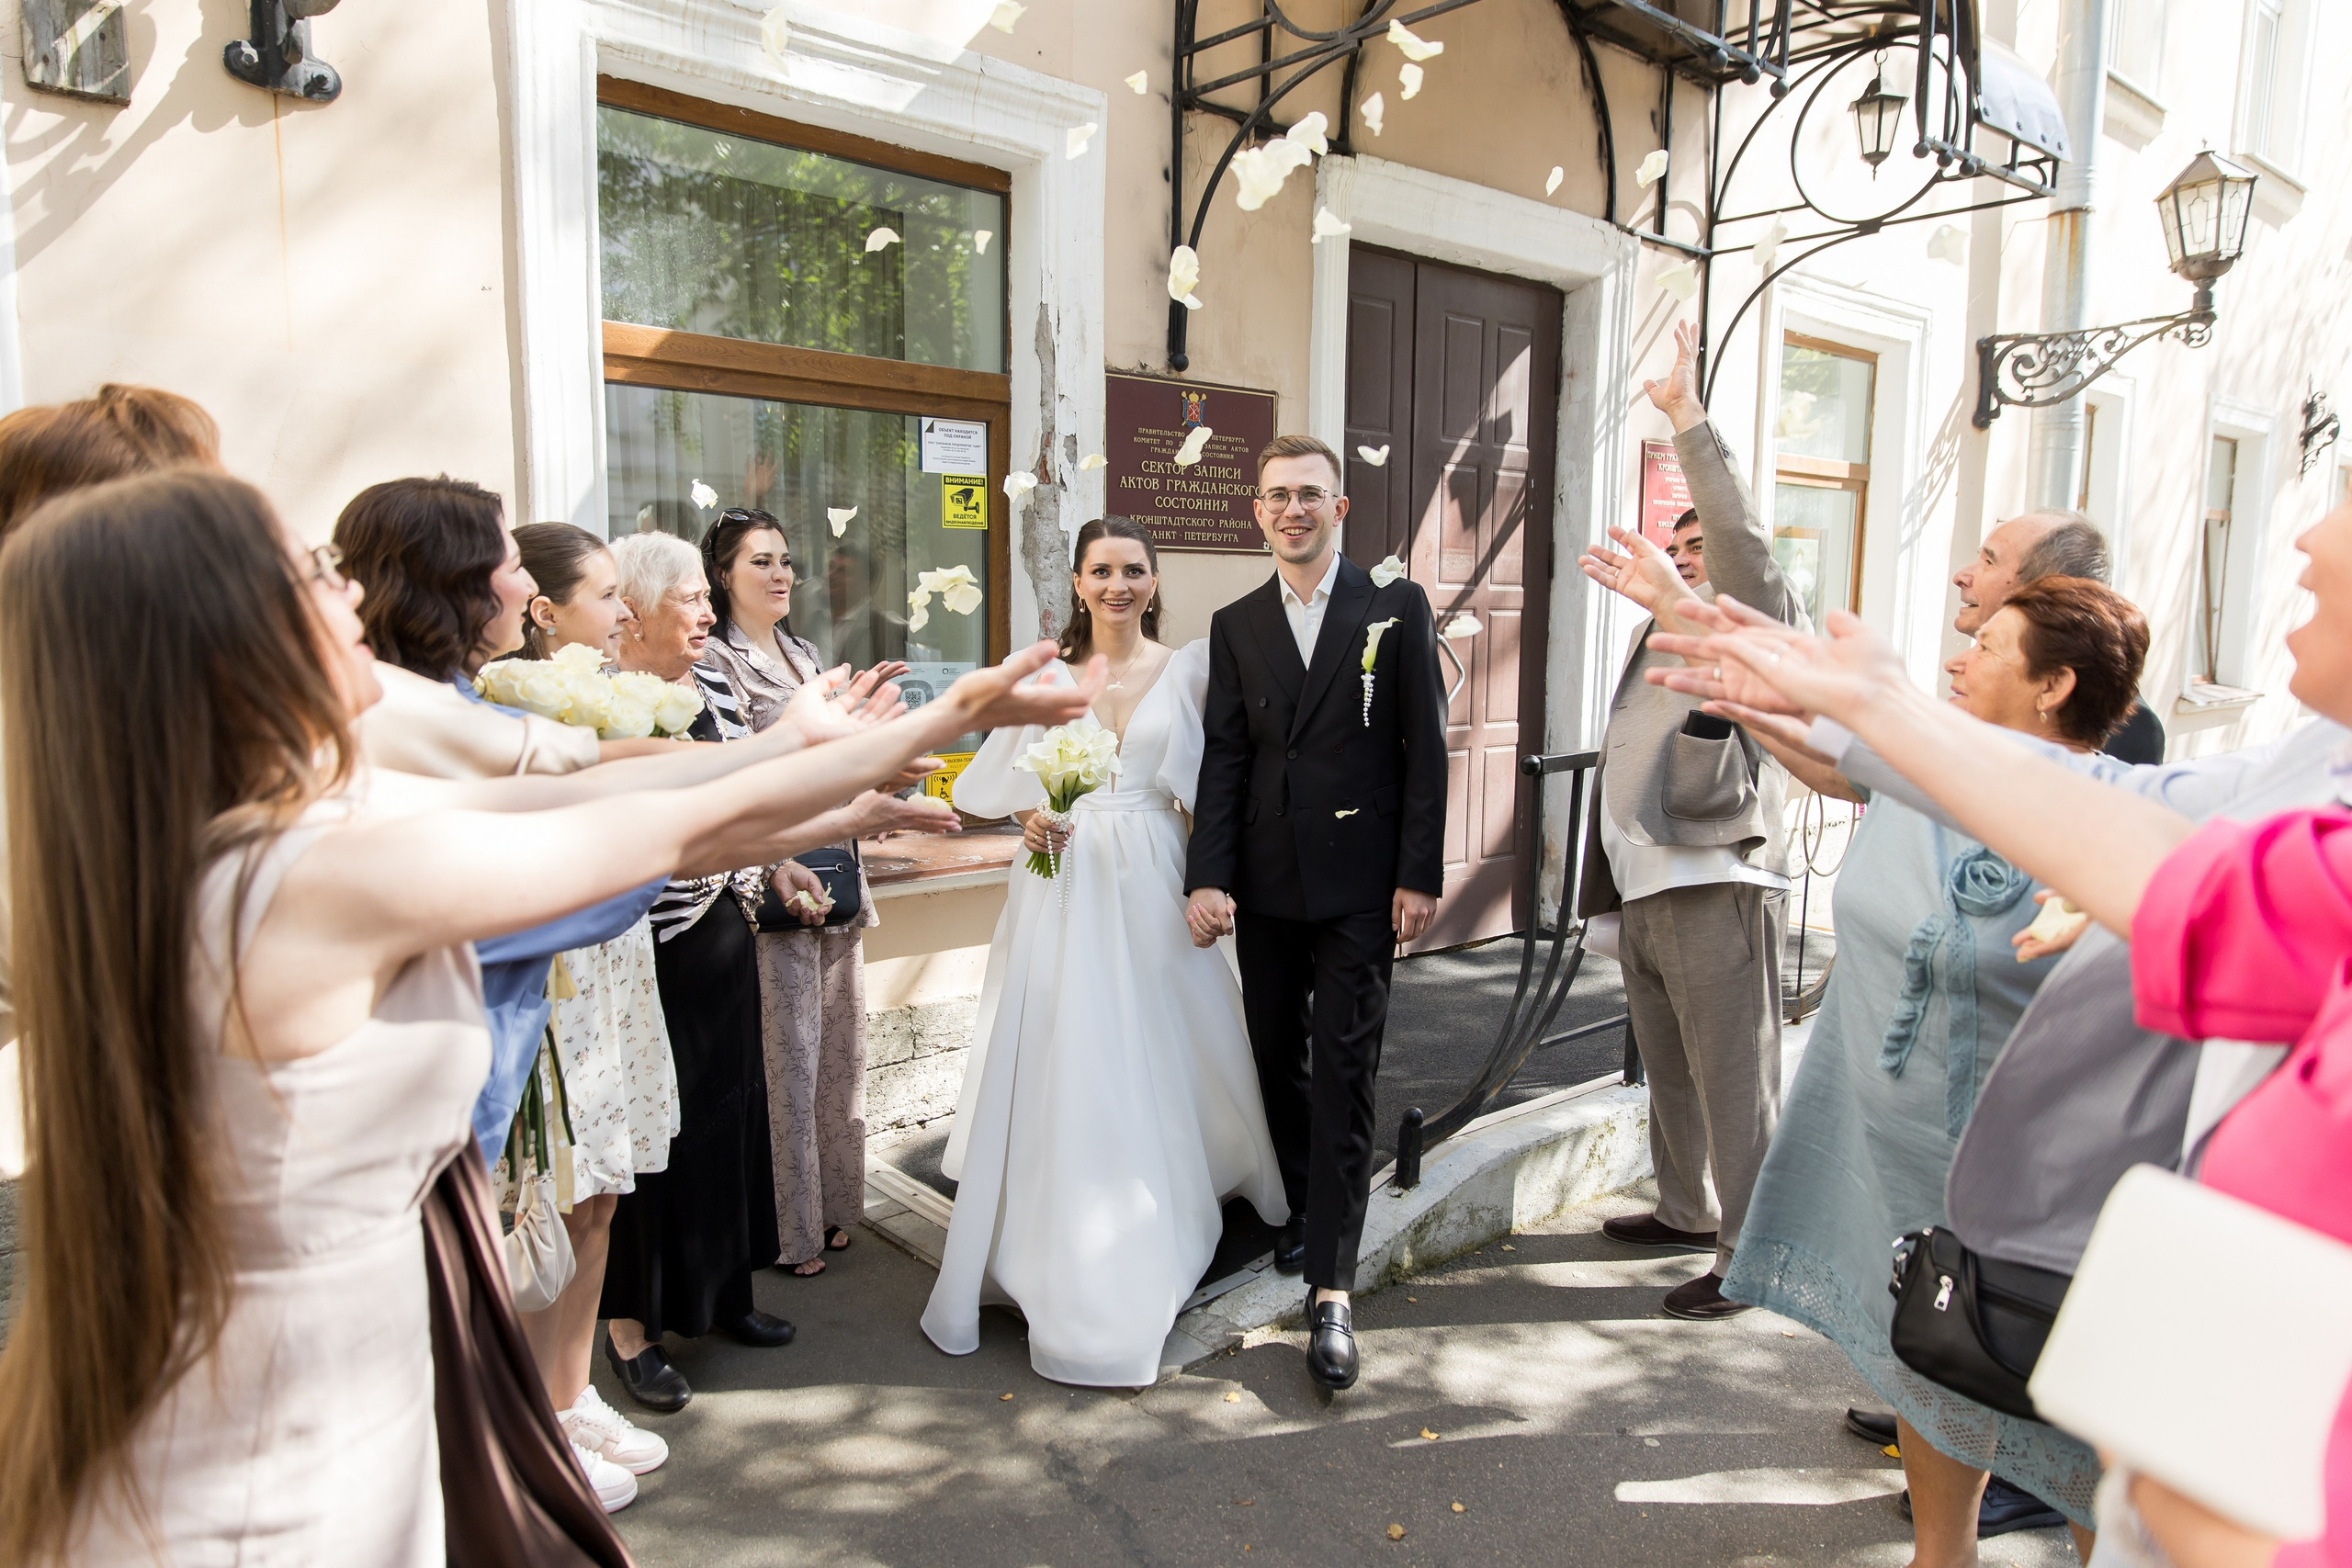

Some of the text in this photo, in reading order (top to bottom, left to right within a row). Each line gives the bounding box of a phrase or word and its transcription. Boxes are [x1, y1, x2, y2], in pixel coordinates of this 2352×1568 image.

[1138, 427, 1185, 437] ПРАВИТЕЛЬСТВО
[1133, 436, 1160, 445] КОМИТЕТ
[1150, 446, 1234, 459] ГРАЖДАН СОСТОЯНИЯ
[1141, 460, 1241, 479] СЕКТОР ЗАПИСИ
[945, 477, 984, 485] ВНИМАНИЕ!
[1119, 476, 1159, 491] АКТОВ
[1155, 496, 1228, 512] СОСТОЯНИЯ
[1130, 514, 1252, 529] КРОНШТАДТСКОГО РАЙОНА
